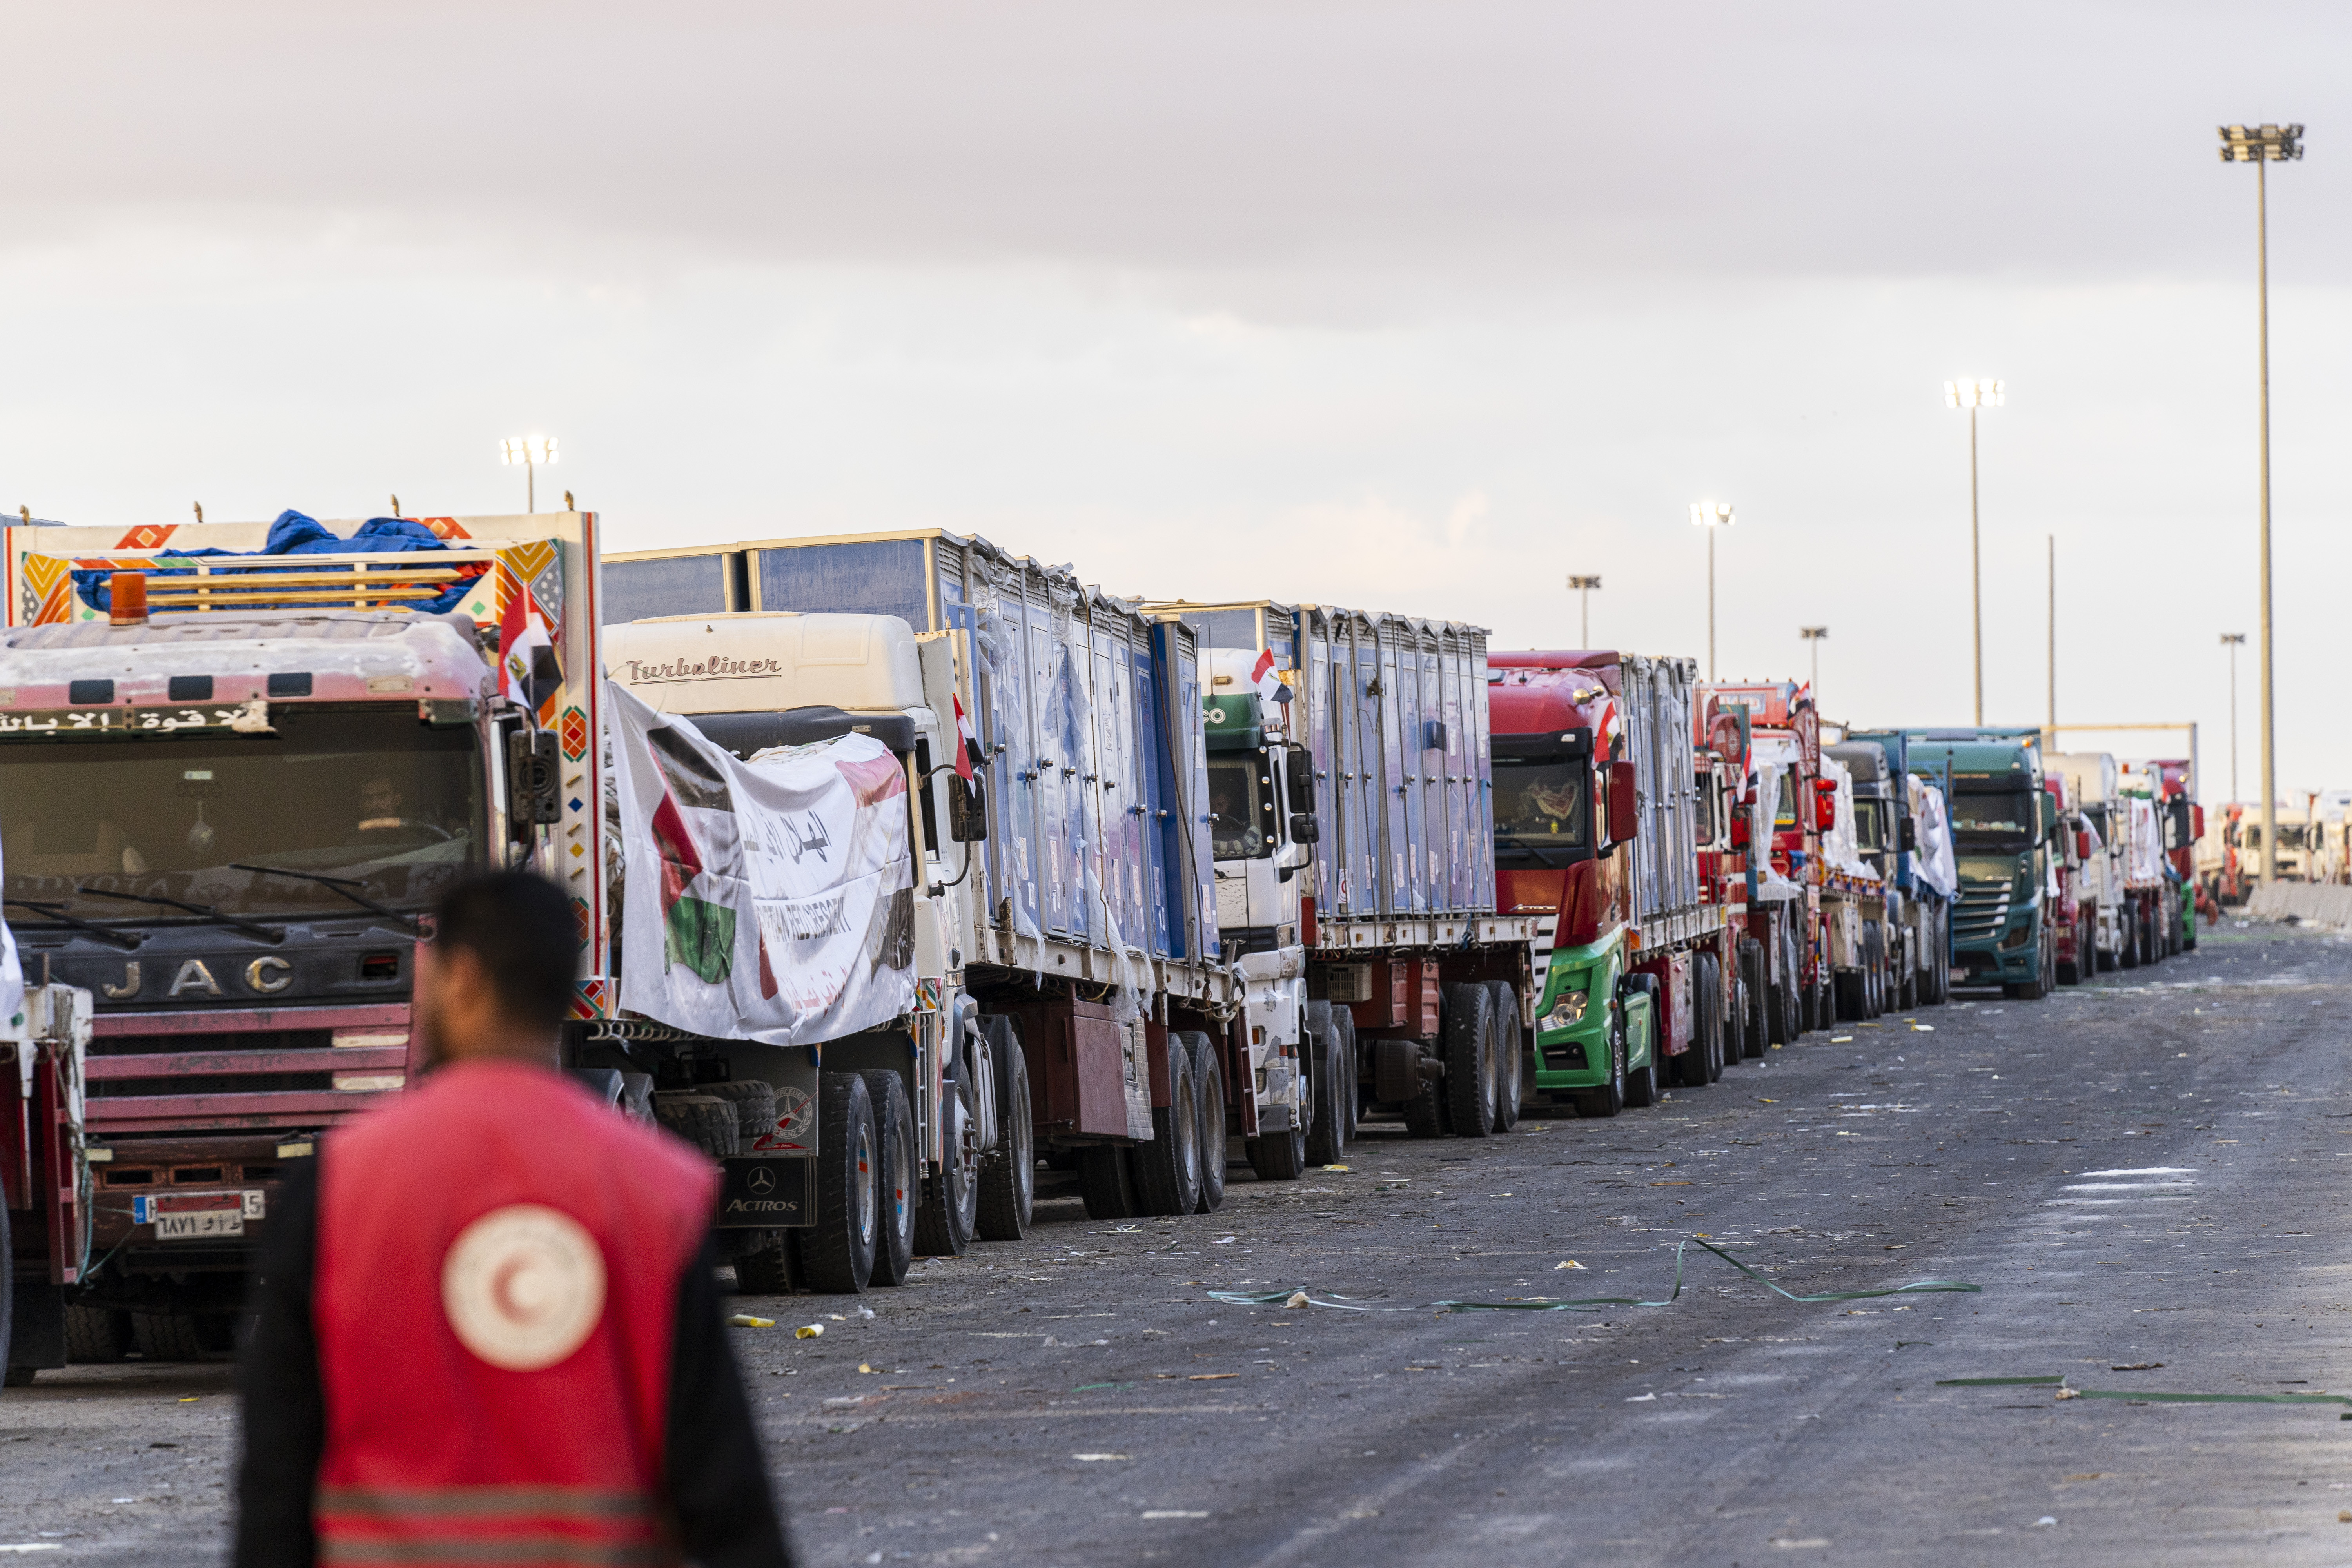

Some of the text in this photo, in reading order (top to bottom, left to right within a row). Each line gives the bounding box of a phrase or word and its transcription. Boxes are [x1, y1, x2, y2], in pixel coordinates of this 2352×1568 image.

[626, 655, 782, 680] Turboliner
[0, 712, 58, 735] بالل
[67, 712, 109, 732] إلا
[140, 710, 206, 732] قوة
[785, 904, 811, 941] RED
[101, 956, 293, 998] JAC
[774, 1088, 806, 1101] ERCEDES
[726, 1199, 798, 1212] ACTROS
[158, 1216, 196, 1234] ٦٨٧١
